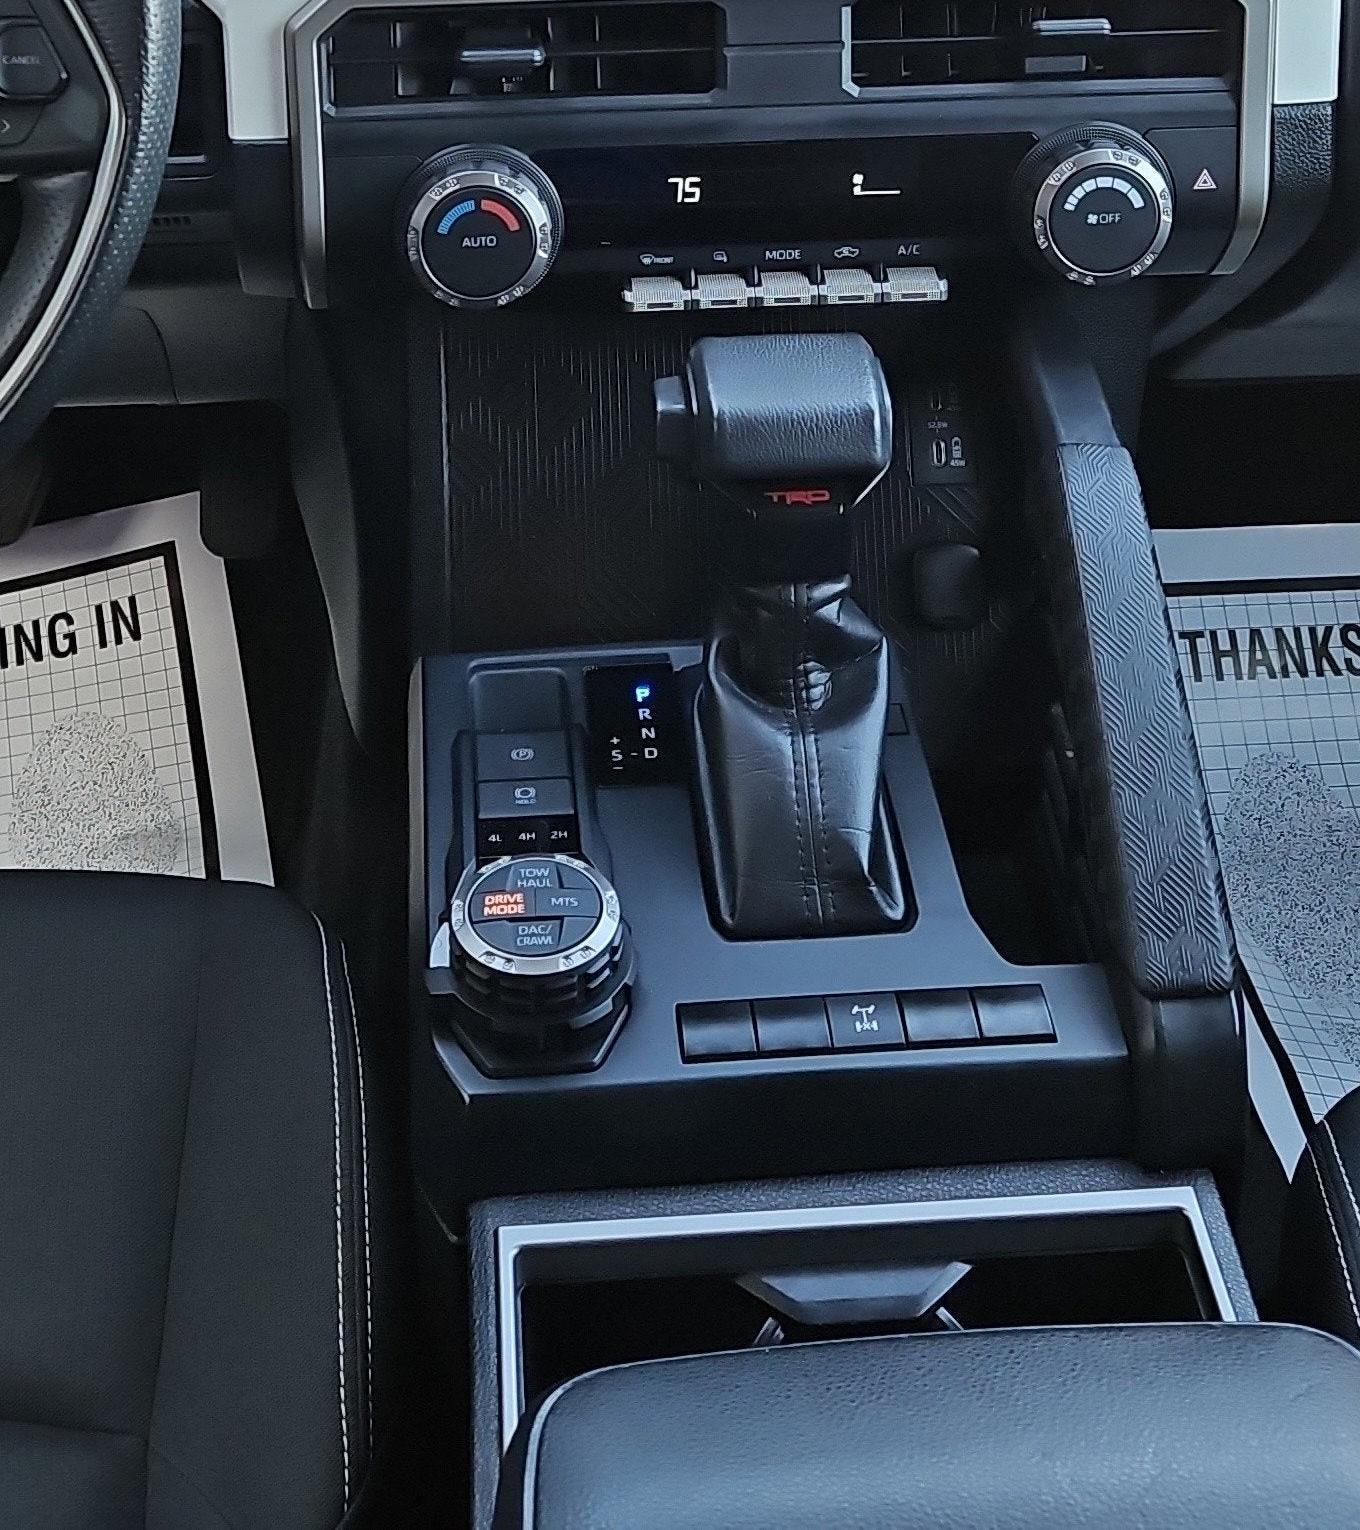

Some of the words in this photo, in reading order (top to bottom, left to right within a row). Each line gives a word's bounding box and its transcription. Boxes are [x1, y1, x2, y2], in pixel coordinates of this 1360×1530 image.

[1, 53, 41, 66] CANCEL
[667, 176, 702, 204] 75
[1099, 212, 1122, 225] OFF
[461, 235, 497, 248] AUTO
[765, 249, 802, 261] MODE
[897, 244, 921, 256] A/C
[764, 489, 831, 505] TRD
[94, 594, 143, 649] IN
[635, 685, 651, 703] P
[637, 708, 653, 721] R
[641, 727, 656, 740] N
[611, 749, 624, 762] S
[644, 747, 658, 759] D
[487, 834, 502, 842] 4L
[517, 832, 536, 841] 4H
[550, 830, 568, 840] 2H
[519, 868, 550, 878] TOW
[517, 878, 553, 889] HAUL
[484, 892, 525, 906] DRIVE
[550, 896, 579, 907] MTS
[483, 904, 526, 917] MODE
[518, 923, 553, 936] DAC/
[516, 935, 554, 947] CRAWL
